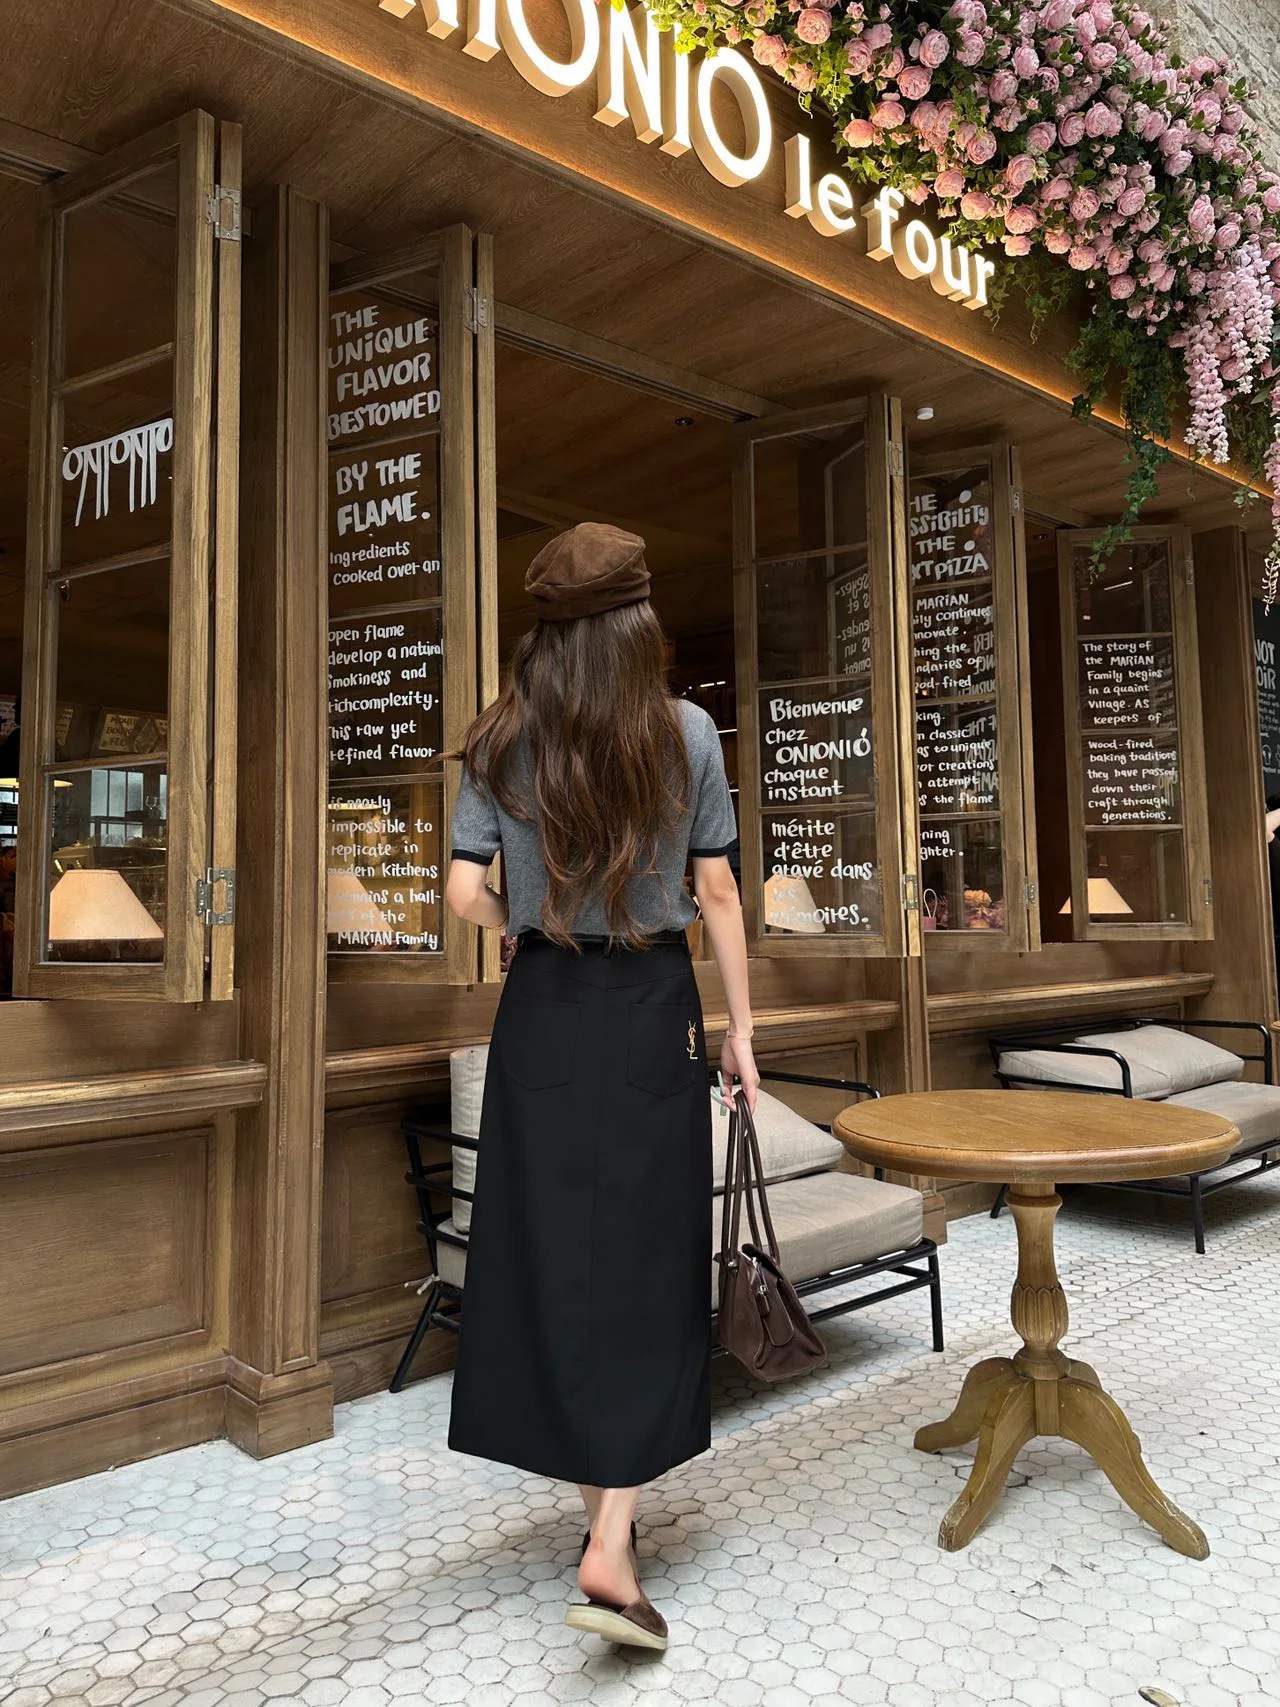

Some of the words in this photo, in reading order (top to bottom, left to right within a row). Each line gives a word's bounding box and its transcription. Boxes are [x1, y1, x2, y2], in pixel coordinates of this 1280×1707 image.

[784, 133, 857, 237] le
[861, 186, 995, 310] four
[331, 305, 380, 338] THE
[336, 352, 431, 402] FLAVOR
[328, 390, 441, 440] BESTOWED
[336, 460, 369, 495] BY
[375, 453, 422, 487] THE
[337, 490, 431, 536] FLAME.
[330, 541, 411, 567] Ingredients
[915, 535, 956, 555] THE
[936, 605, 992, 621] continues
[328, 629, 359, 646] open
[364, 624, 405, 643] flame
[944, 643, 967, 653] the
[1082, 643, 1103, 652] The
[1106, 642, 1137, 653] story
[1139, 640, 1152, 651] of
[328, 649, 382, 666] develop
[387, 647, 397, 660] a
[967, 656, 982, 675] of
[1085, 656, 1103, 665] the
[401, 662, 427, 680] and
[1087, 670, 1122, 683] Family
[1128, 669, 1163, 682] begins
[1088, 685, 1099, 695] in
[1103, 686, 1111, 694] a
[1113, 683, 1150, 696] quaint
[769, 697, 864, 723] Bienvenue
[1094, 713, 1139, 726] keepers
[1147, 712, 1161, 724] of
[356, 724, 384, 737] raw
[391, 720, 417, 739] yet
[765, 728, 809, 744] chez
[929, 730, 969, 741] classic
[330, 744, 382, 765] refined
[389, 744, 436, 759] flavor
[934, 745, 948, 753] to
[950, 740, 991, 756] unique
[938, 759, 994, 772] creations
[1090, 753, 1127, 765] baking
[1129, 751, 1177, 761] traditions
[764, 767, 830, 785] chaque
[928, 773, 981, 789] attempt
[1087, 769, 1109, 781] they
[1114, 768, 1138, 778] have
[1142, 767, 1175, 778] passed
[768, 779, 844, 801] instant
[1092, 784, 1123, 793] down
[1129, 783, 1158, 793] their
[933, 794, 954, 804] the
[958, 792, 994, 807] flame
[1088, 797, 1118, 811] craft
[1121, 796, 1168, 808] through
[1102, 809, 1172, 824] generations.
[331, 819, 406, 838] impossible
[414, 819, 433, 832] to
[771, 818, 836, 837] mérite
[331, 843, 392, 861] replicate
[404, 841, 419, 853] in
[774, 841, 833, 861] d'être
[382, 863, 438, 879] kitchens
[830, 858, 873, 880] dans
[393, 892, 405, 904] a
[410, 888, 441, 904] hall-
[380, 909, 406, 923] the
[395, 931, 438, 950] Family
